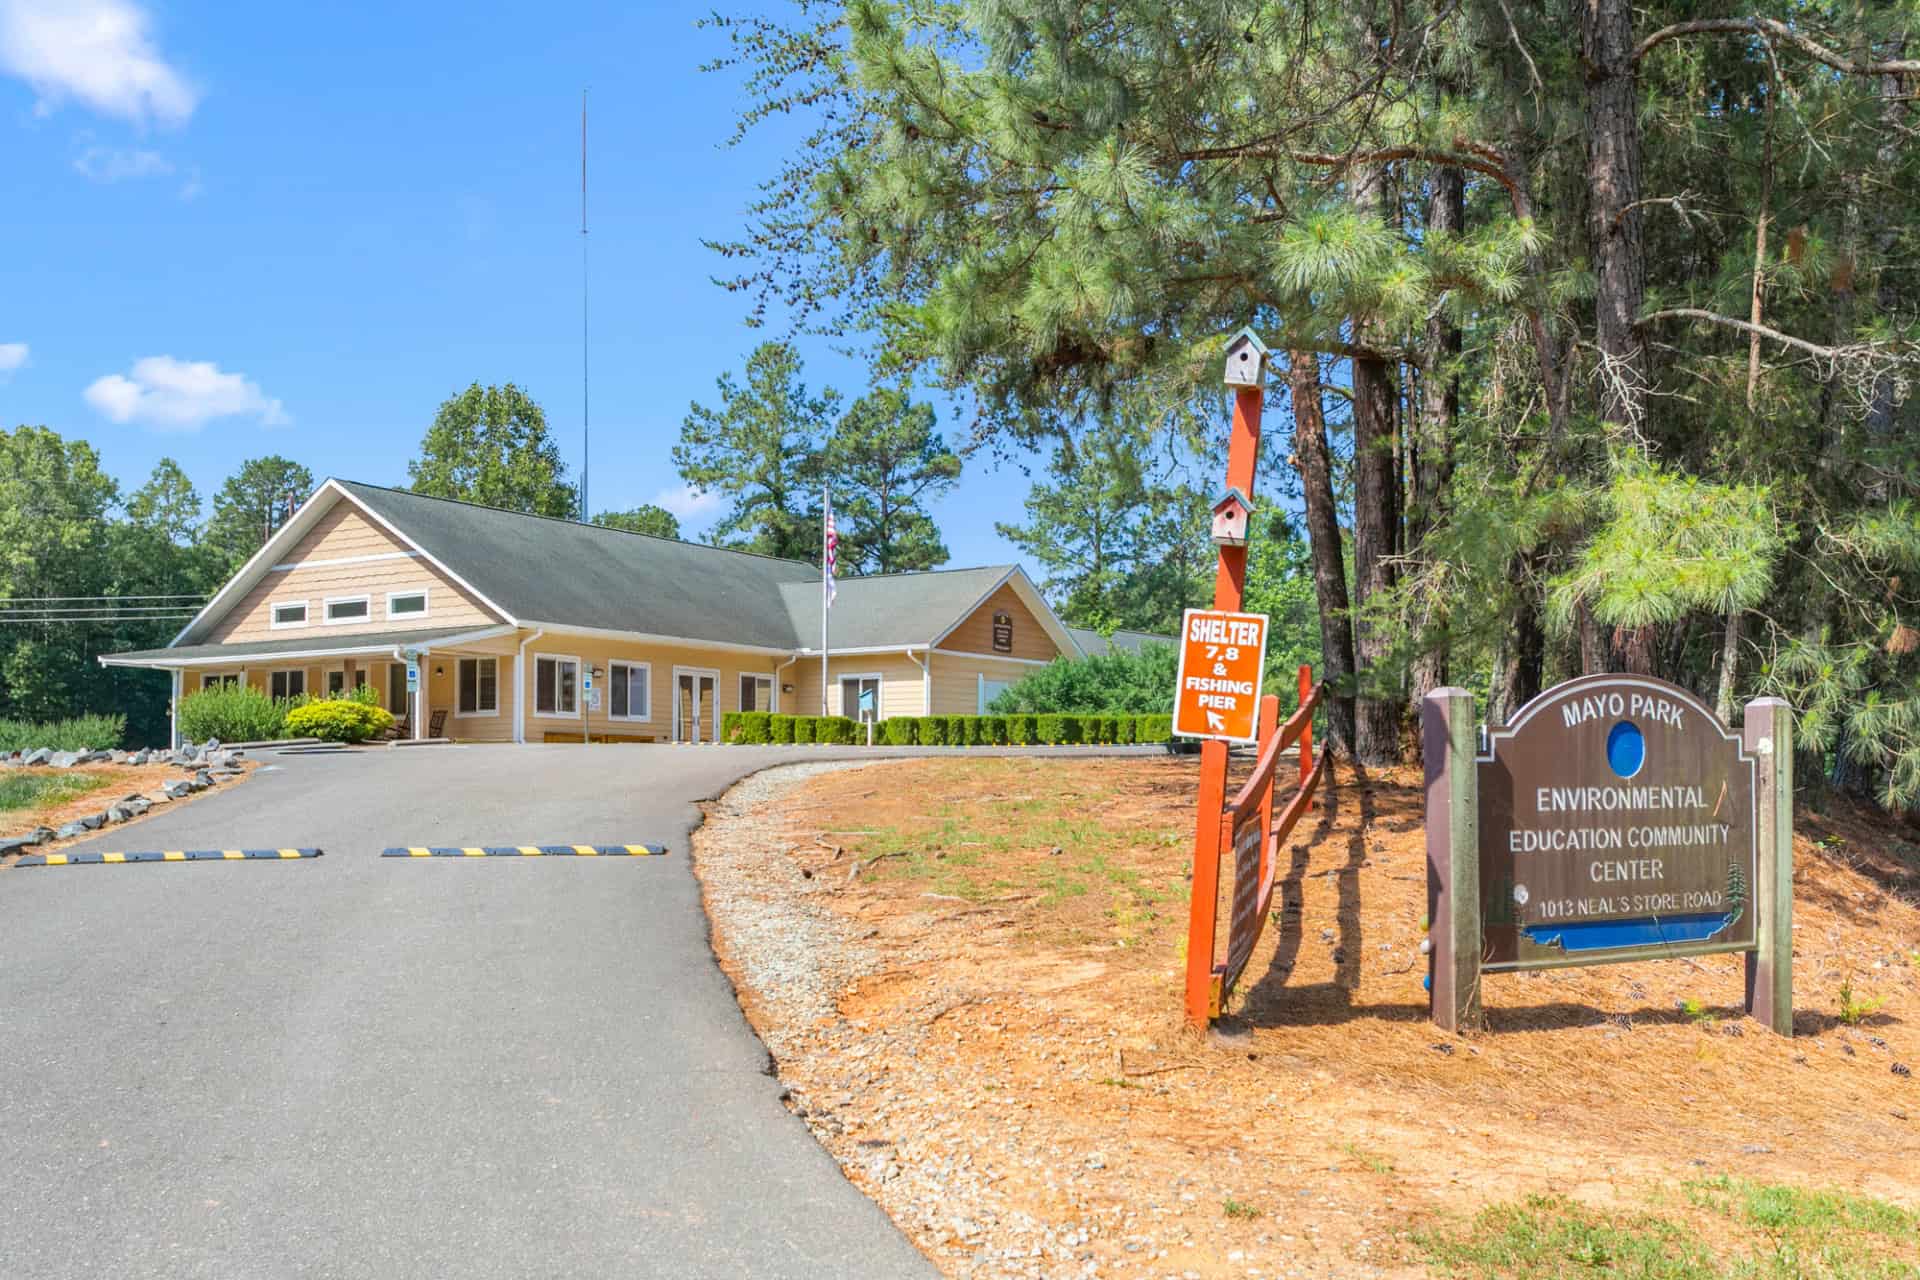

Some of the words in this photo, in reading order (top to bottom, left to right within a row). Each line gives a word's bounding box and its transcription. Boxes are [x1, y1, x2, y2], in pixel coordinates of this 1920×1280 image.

[1190, 618, 1259, 647] SHELTER
[1205, 646, 1239, 661] 7,8
[1212, 662, 1227, 676] &
[1186, 677, 1253, 695] FISHING
[1198, 694, 1236, 710] PIER
[1562, 693, 1624, 728] MAYO
[1631, 693, 1685, 729] PARK
[1536, 786, 1708, 812] ENVIRONMENTAL
[1510, 828, 1622, 852] EDUCATION
[1627, 824, 1730, 848] COMMUNITY
[1590, 859, 1663, 882] CENTER
[1539, 900, 1574, 917] 1013
[1578, 896, 1631, 915] NEAL'S
[1634, 894, 1680, 911] STORE
[1684, 891, 1722, 909] ROAD
